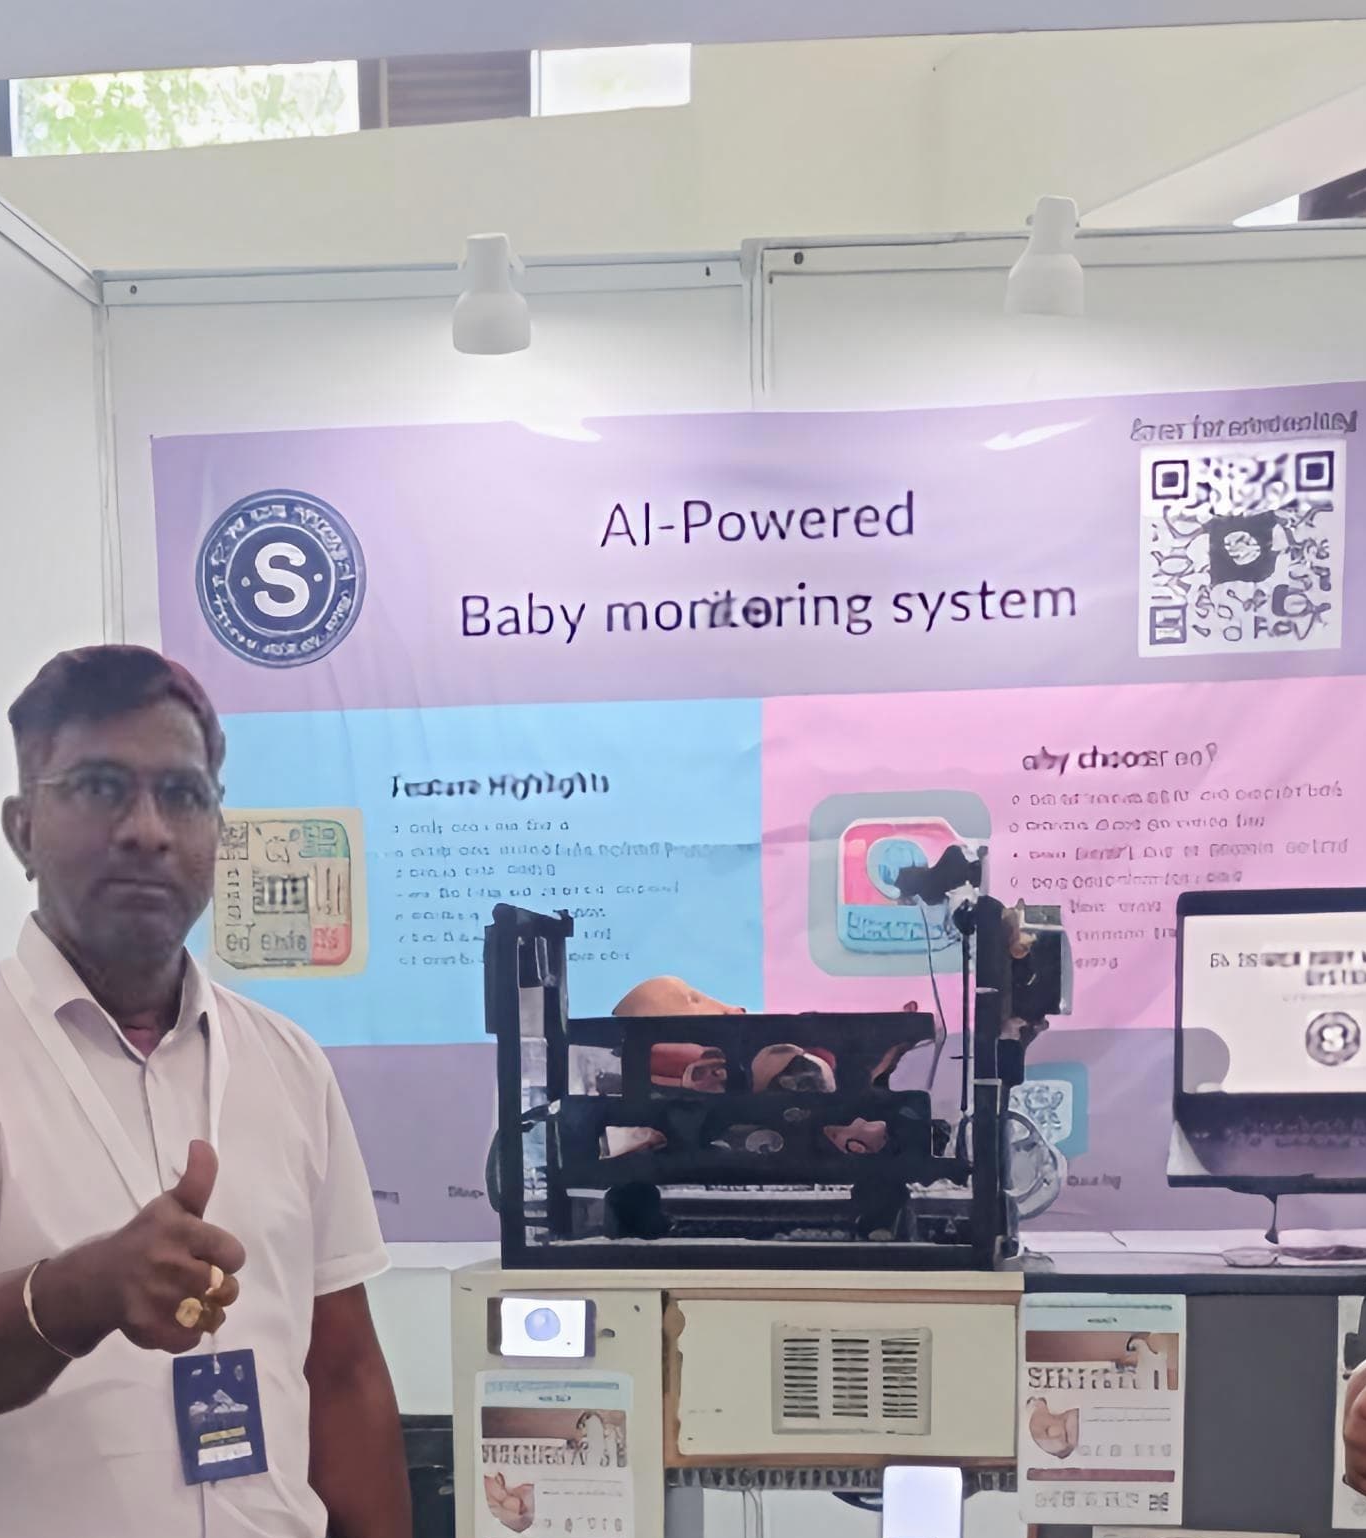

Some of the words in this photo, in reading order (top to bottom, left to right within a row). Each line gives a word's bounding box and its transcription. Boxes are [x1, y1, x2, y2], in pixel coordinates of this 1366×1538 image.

[600, 490, 914, 547] AI-Powered
[462, 592, 585, 643] Baby
[606, 582, 872, 635] monitoring
[892, 580, 1076, 629] system
